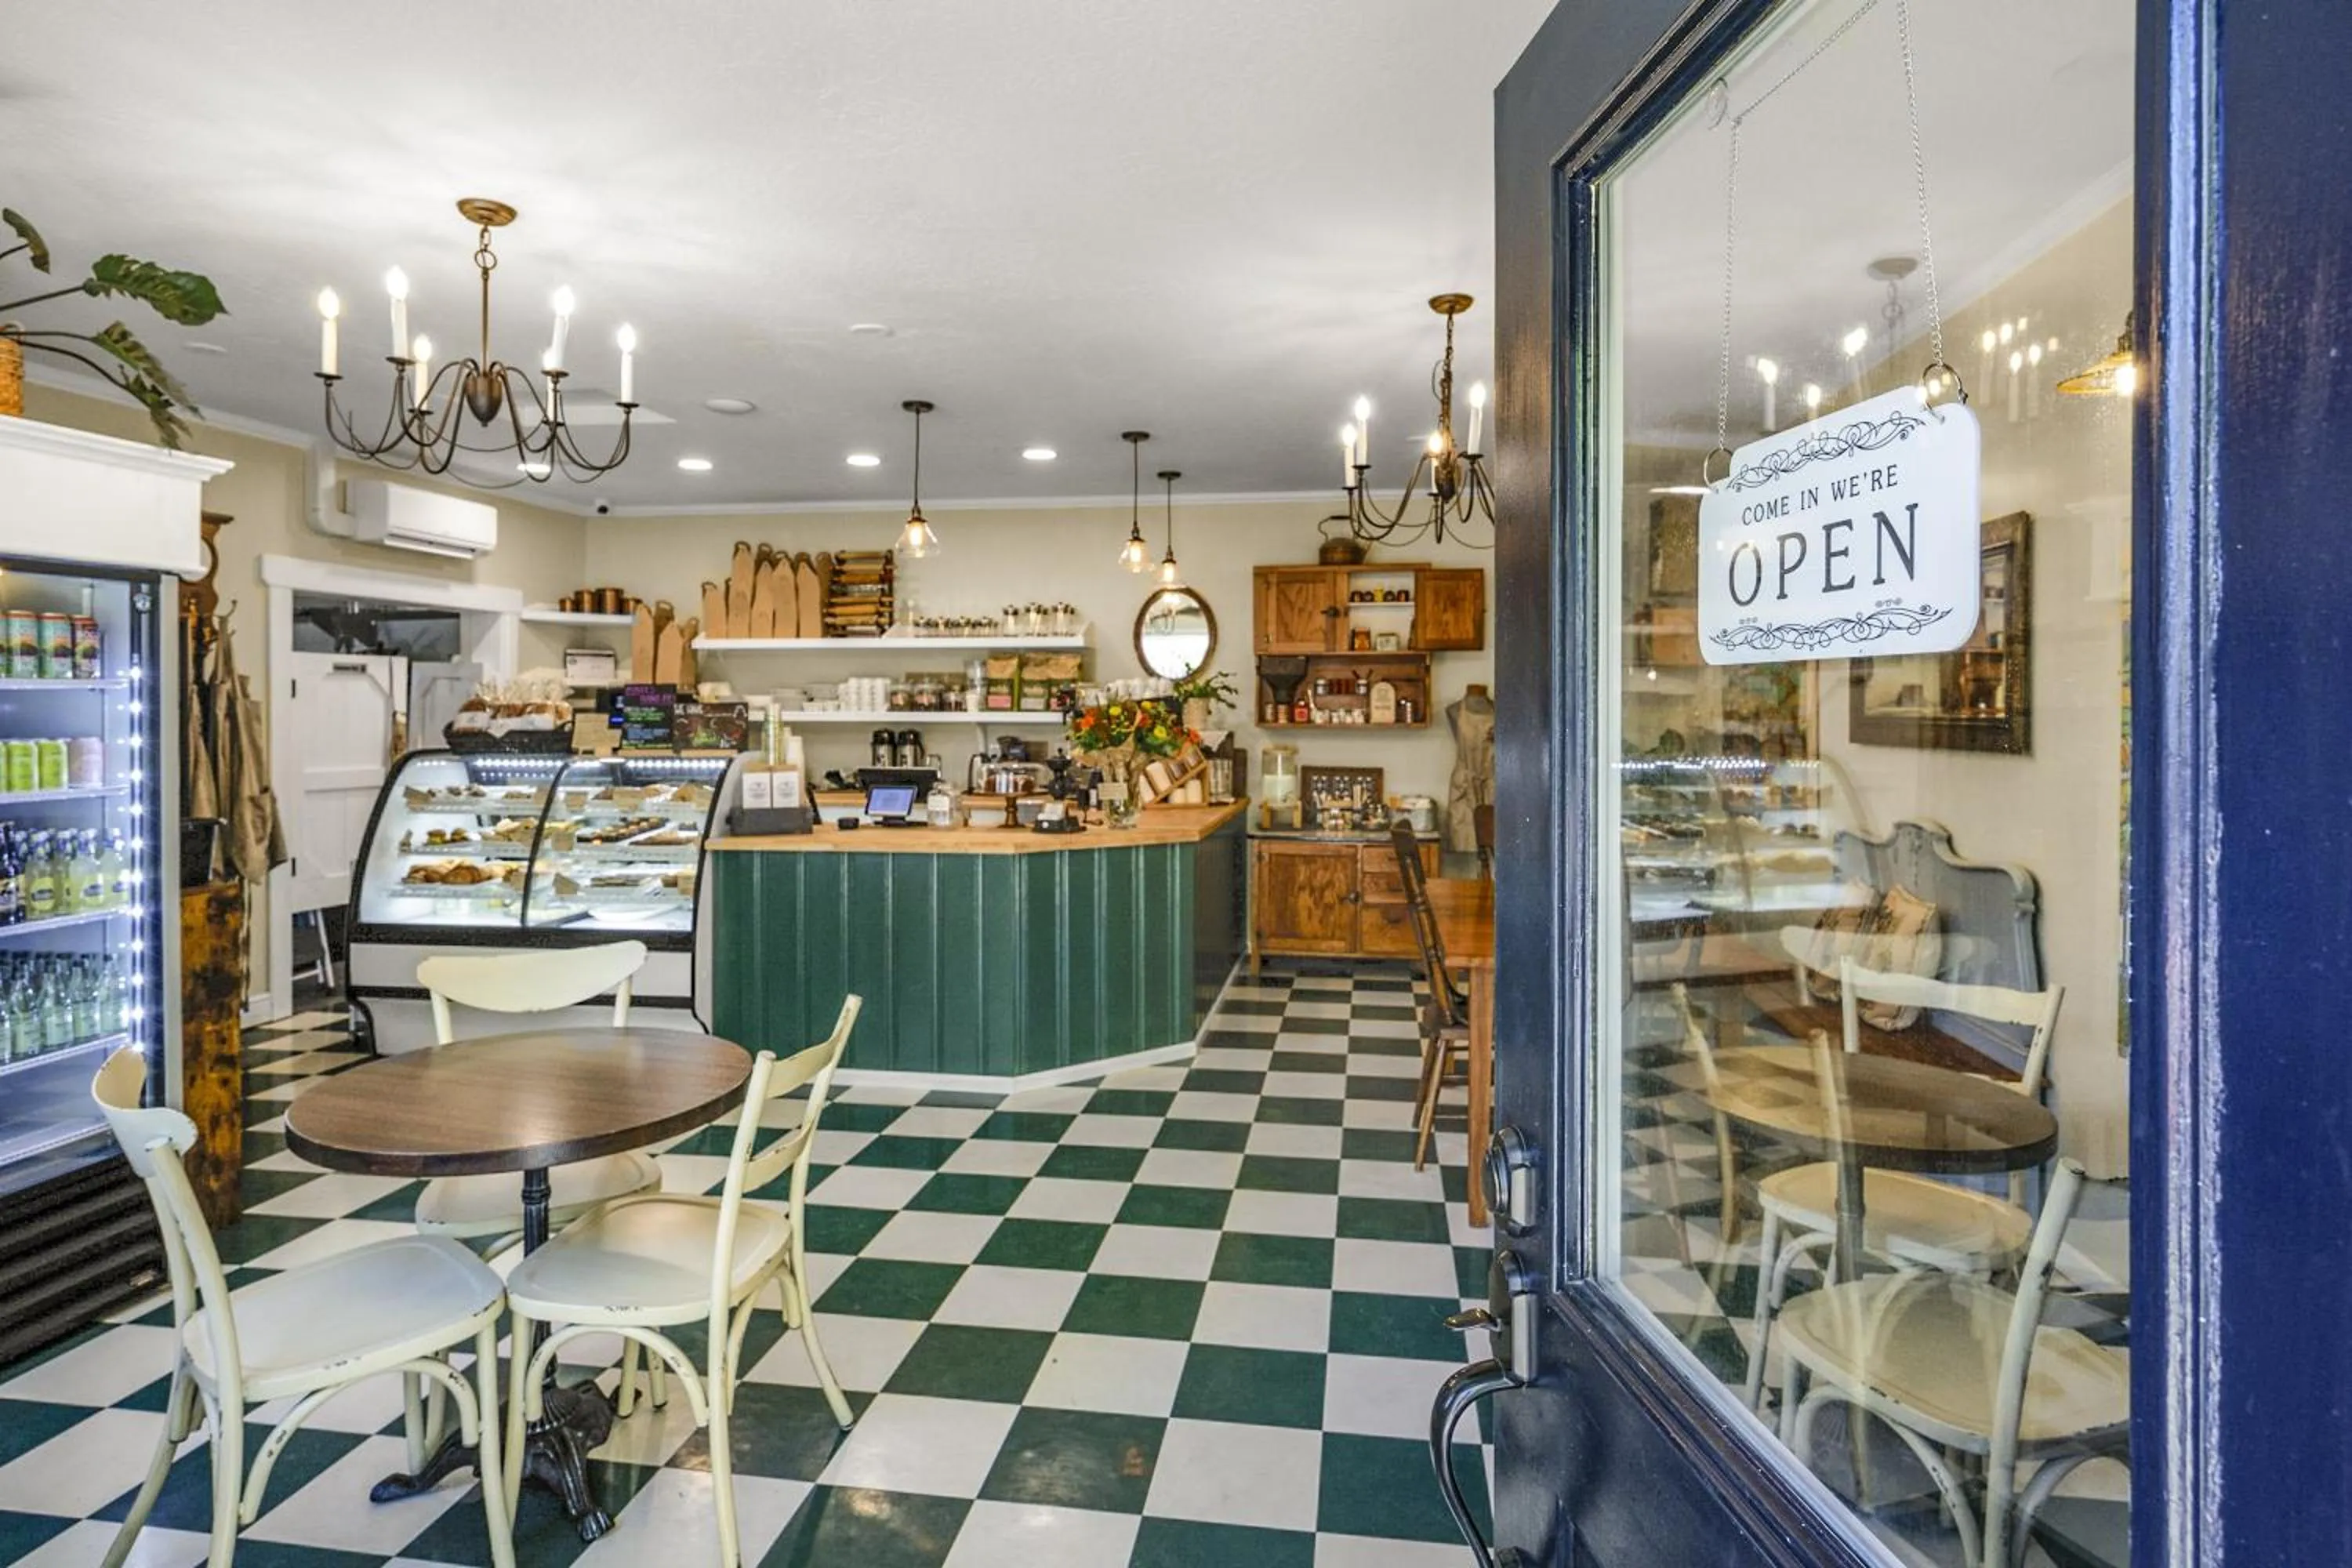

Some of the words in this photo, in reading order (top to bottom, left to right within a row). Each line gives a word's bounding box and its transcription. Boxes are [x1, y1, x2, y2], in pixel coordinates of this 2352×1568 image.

[1741, 495, 1791, 527] COME
[1800, 486, 1820, 510] IN
[1831, 463, 1899, 502] WE'RE
[1729, 503, 1919, 607] OPEN
